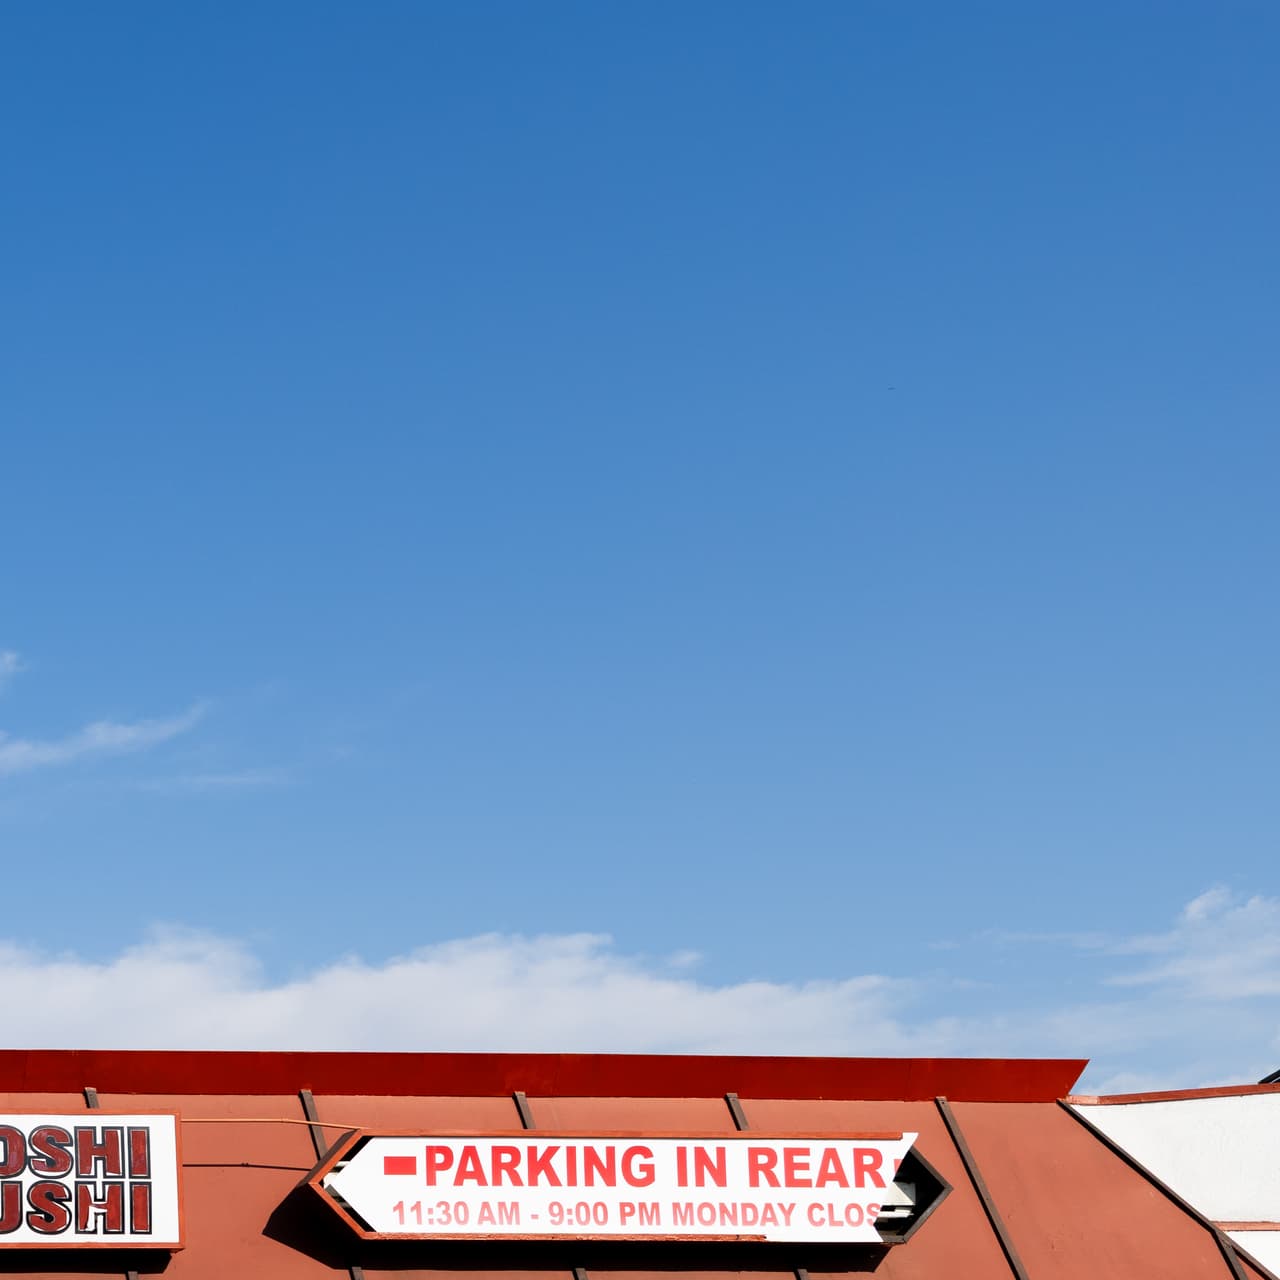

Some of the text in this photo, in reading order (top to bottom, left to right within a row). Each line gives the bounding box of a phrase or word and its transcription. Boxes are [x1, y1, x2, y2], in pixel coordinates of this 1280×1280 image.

[424, 1145, 887, 1189] PARKING IN REAR
[392, 1200, 470, 1226] 11:30
[477, 1201, 521, 1226] AM
[547, 1201, 609, 1226] 9:00
[619, 1202, 662, 1226] PM
[671, 1202, 797, 1227] MONDAY
